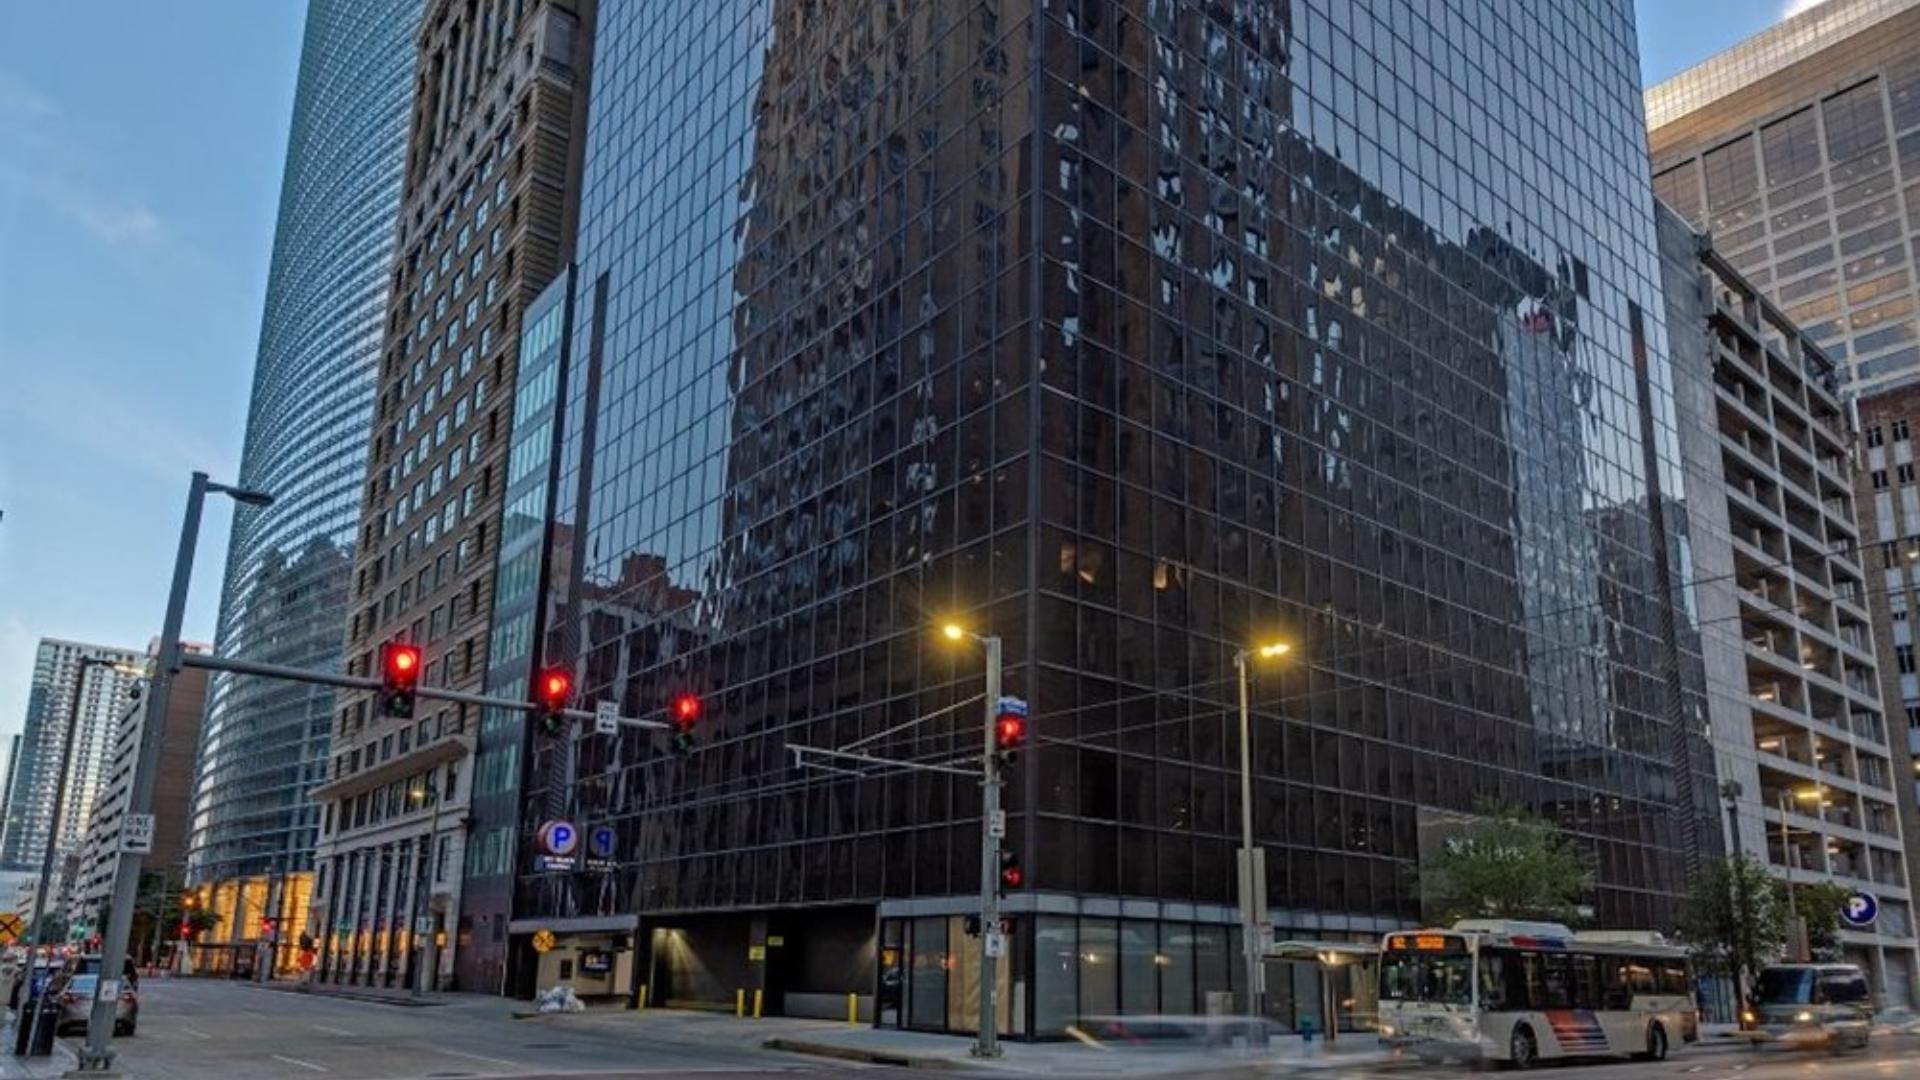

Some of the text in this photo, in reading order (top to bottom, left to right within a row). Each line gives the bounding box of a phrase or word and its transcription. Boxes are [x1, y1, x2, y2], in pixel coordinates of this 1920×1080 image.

[127, 816, 151, 826] ONE
[554, 827, 570, 849] P
[1849, 898, 1867, 918] P
